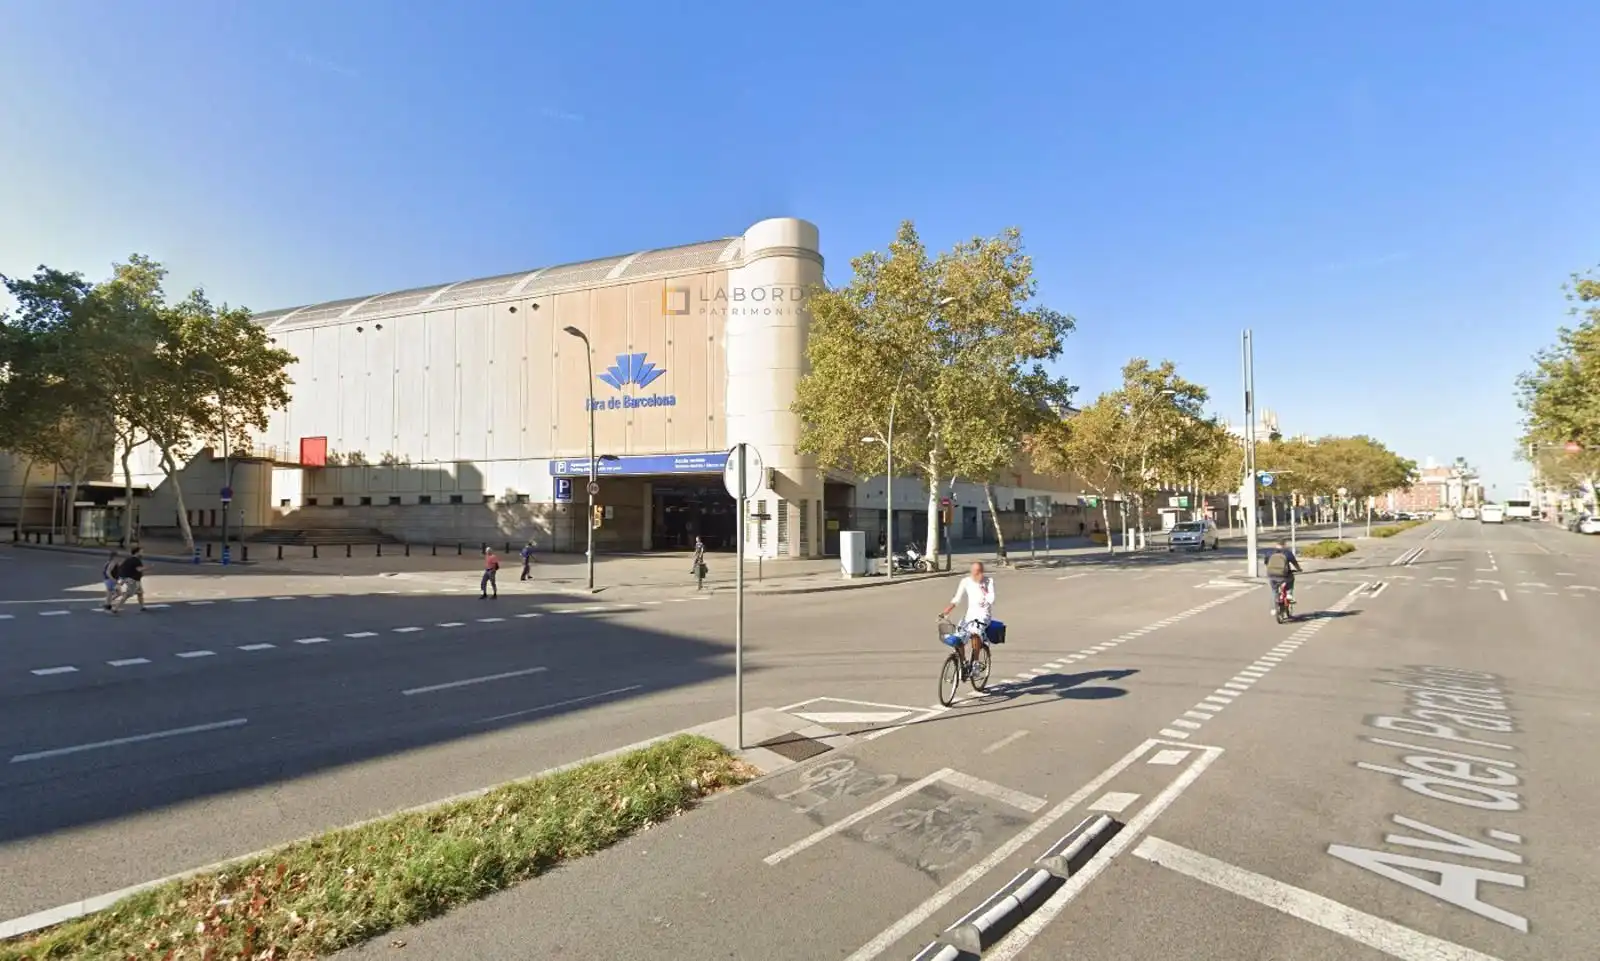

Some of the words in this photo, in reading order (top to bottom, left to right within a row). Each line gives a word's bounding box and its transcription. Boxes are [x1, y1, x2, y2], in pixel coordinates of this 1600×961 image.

[608, 396, 621, 410] de
[623, 393, 676, 409] Barcelona
[559, 479, 569, 493] P
